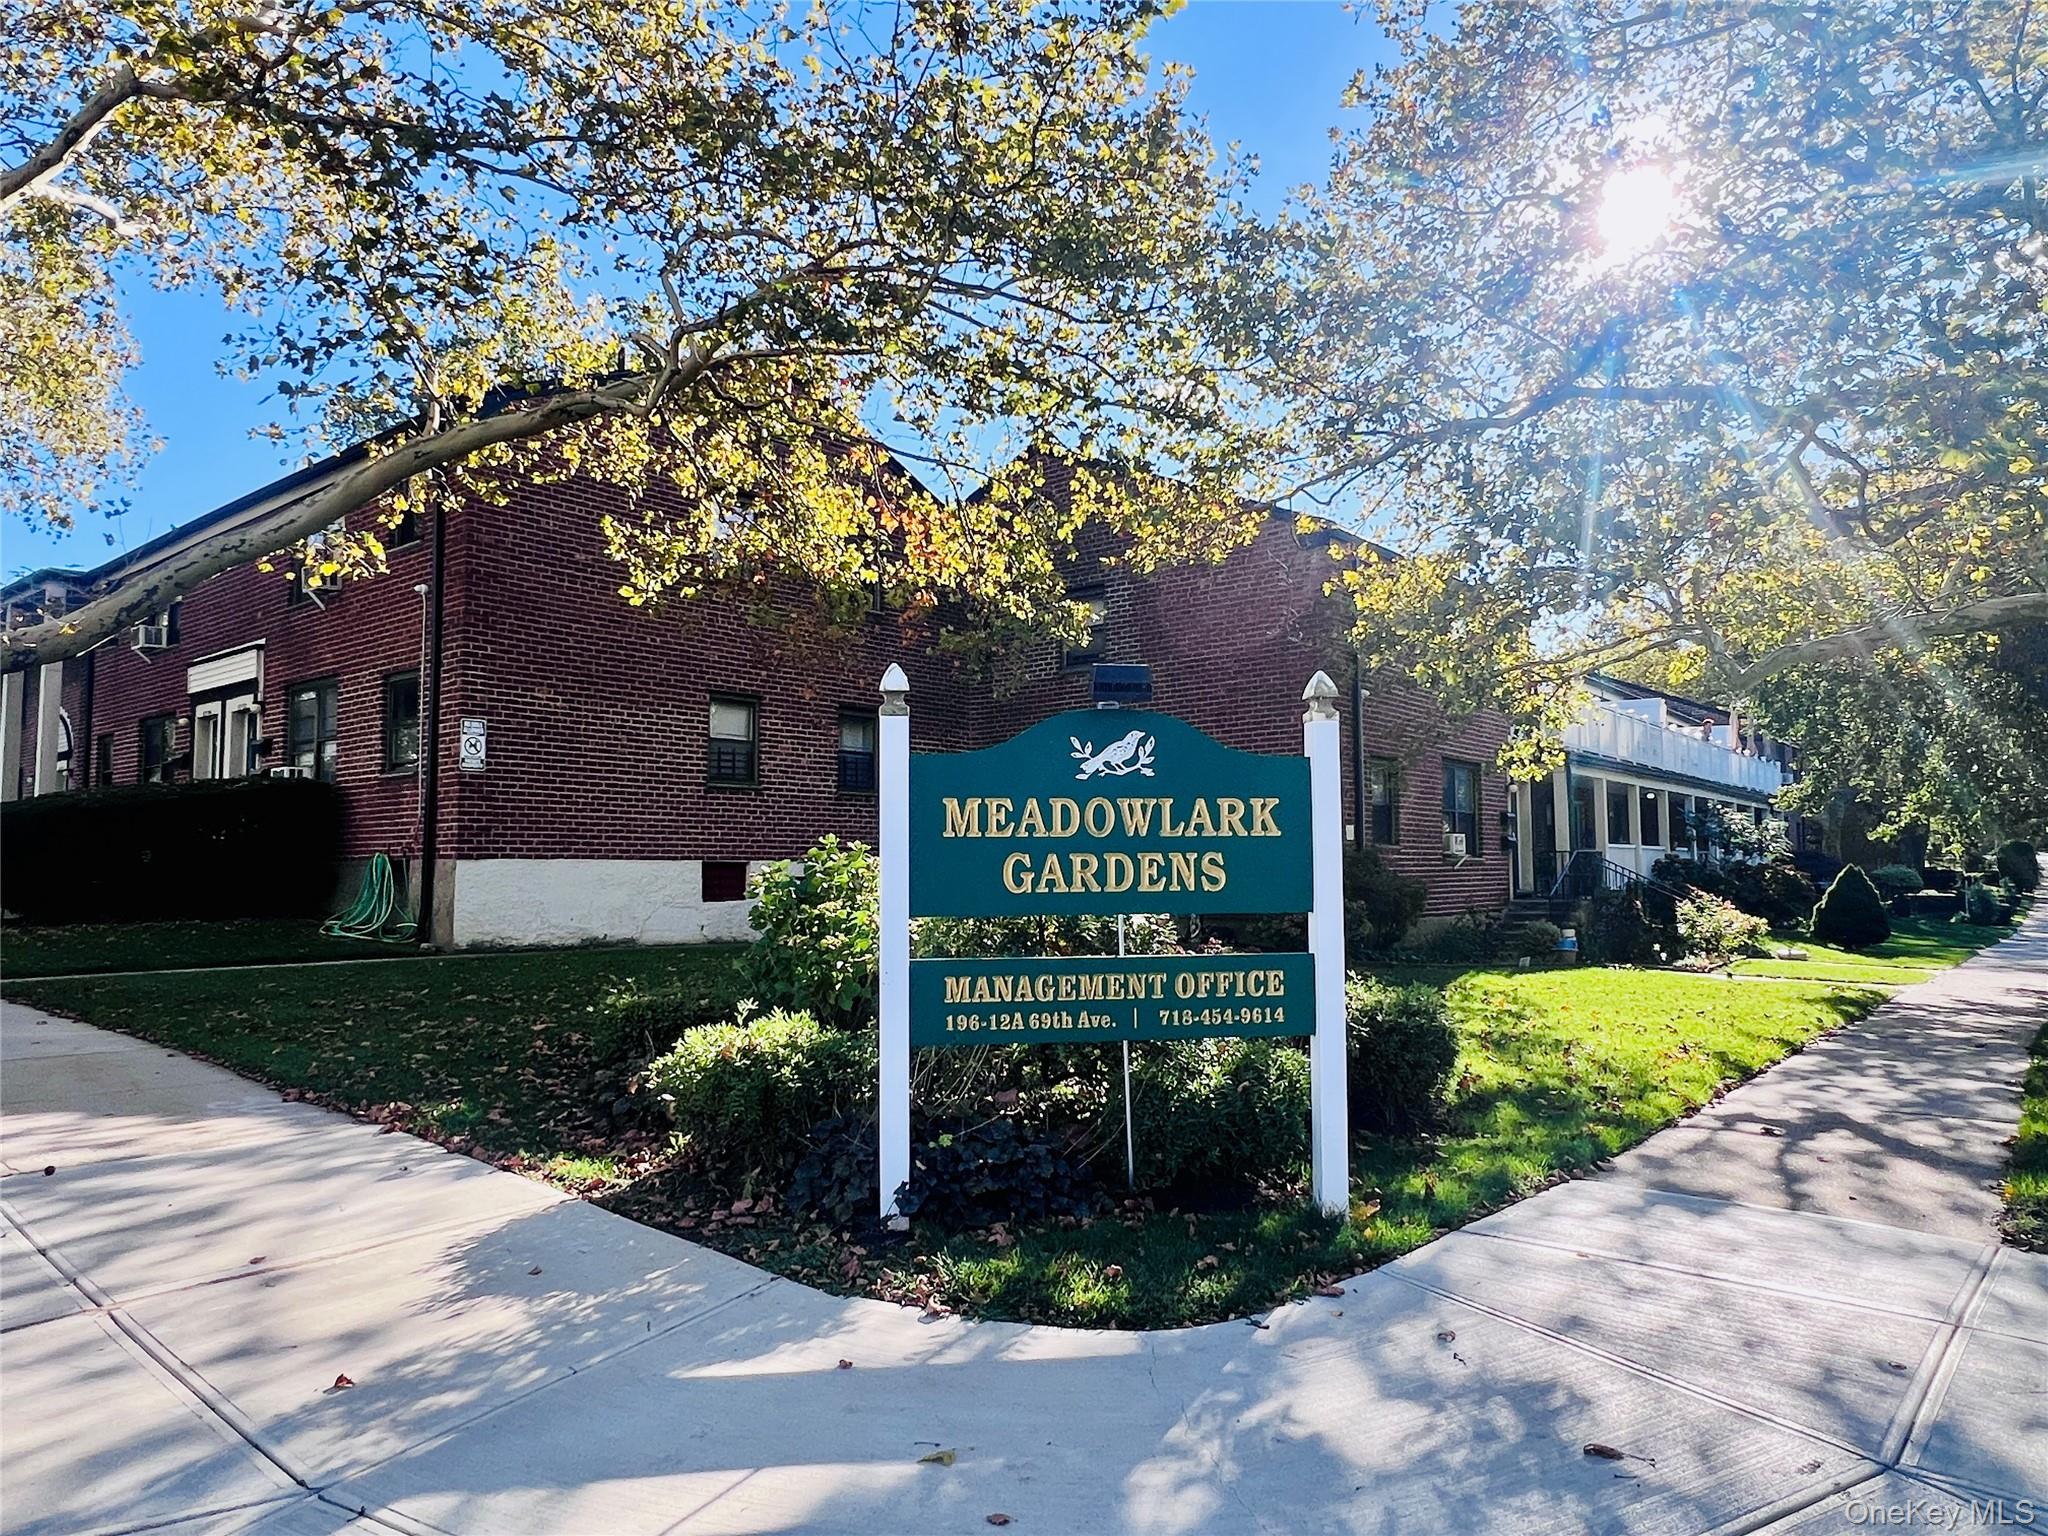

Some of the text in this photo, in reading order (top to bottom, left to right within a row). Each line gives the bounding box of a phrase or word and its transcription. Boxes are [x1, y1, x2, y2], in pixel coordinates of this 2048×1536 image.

[942, 797, 1281, 838] MEADOWLARK
[1002, 851, 1227, 894] GARDENS
[944, 970, 1285, 1003] MANAGEMENT OFFICE
[946, 1007, 1285, 1031] 196-12A 69th Ave. 718-454-9614
